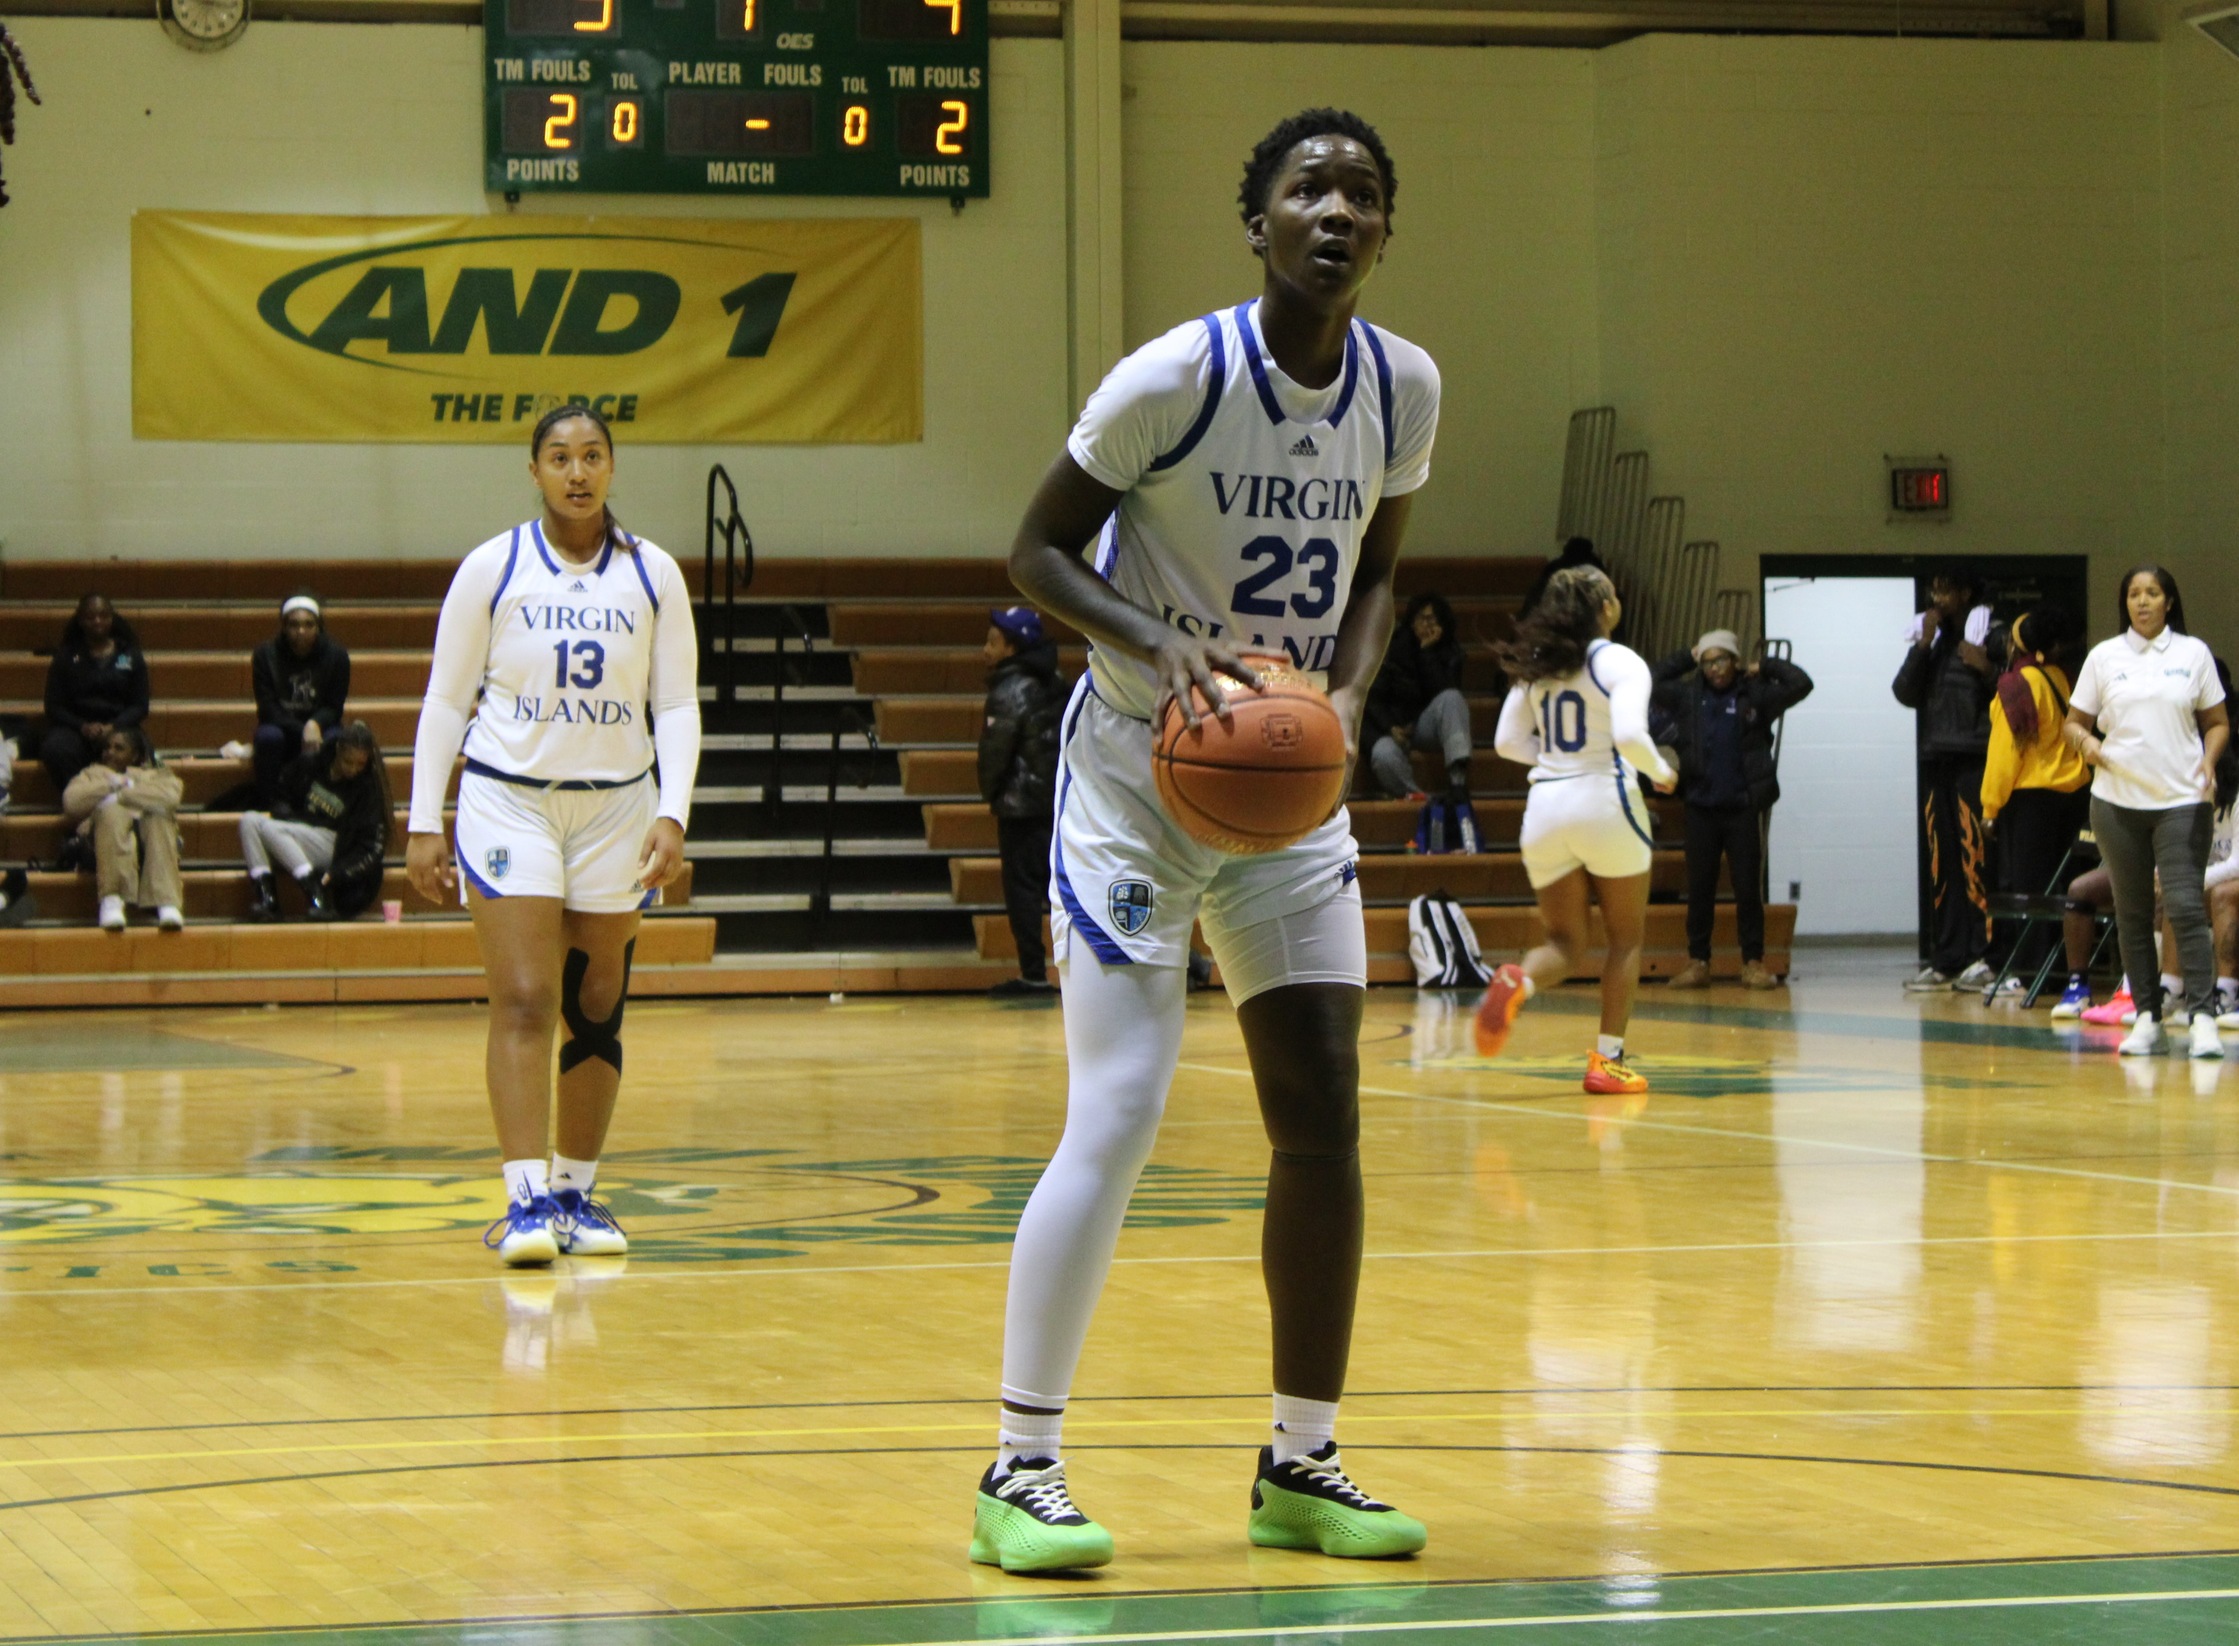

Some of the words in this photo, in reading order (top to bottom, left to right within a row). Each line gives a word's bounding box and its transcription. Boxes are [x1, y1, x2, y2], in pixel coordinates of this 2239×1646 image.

[494, 58, 524, 81] TM
[532, 58, 590, 81] FOULS
[611, 72, 638, 91] TOL
[669, 62, 742, 85] PLAYER
[764, 63, 822, 86] FOULS
[888, 66, 918, 88] TM
[923, 66, 981, 89] FOULS
[842, 76, 868, 94] TOL
[544, 94, 576, 148] 2
[613, 101, 637, 142] 0
[843, 106, 868, 145] 0
[936, 101, 968, 154] 2
[506, 159, 580, 182] POINTS
[707, 162, 775, 184] MATCH
[900, 165, 971, 187] POINTS
[304, 267, 682, 356] AND
[720, 271, 797, 358] 1
[431, 393, 503, 422] THE
[1209, 472, 1365, 520] VIRGIN
[1230, 535, 1339, 619] 23
[520, 605, 635, 635] VIRGIN
[553, 639, 604, 689] 13
[512, 695, 632, 726] ISLANDS
[1540, 690, 1587, 753] 10
